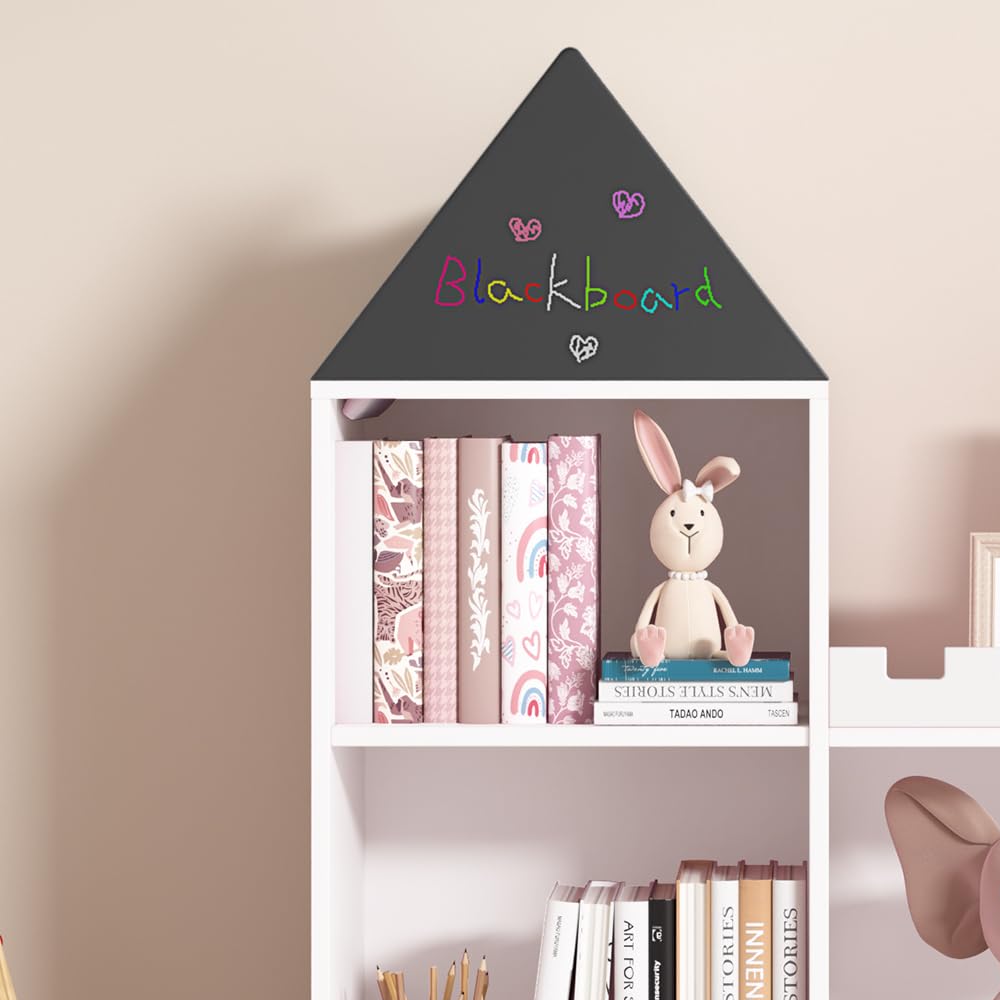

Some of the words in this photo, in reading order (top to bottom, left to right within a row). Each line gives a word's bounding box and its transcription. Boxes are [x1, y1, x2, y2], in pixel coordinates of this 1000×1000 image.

[435, 253, 722, 313] Blackboard
[614, 685, 676, 698] STORIES
[679, 685, 725, 698] STYLE
[728, 685, 773, 698] MEN'S
[669, 709, 697, 718] TADAO
[700, 709, 724, 718] ANDO
[767, 709, 790, 718] TASCEN
[623, 920, 634, 951] ART
[623, 957, 634, 990] FOR
